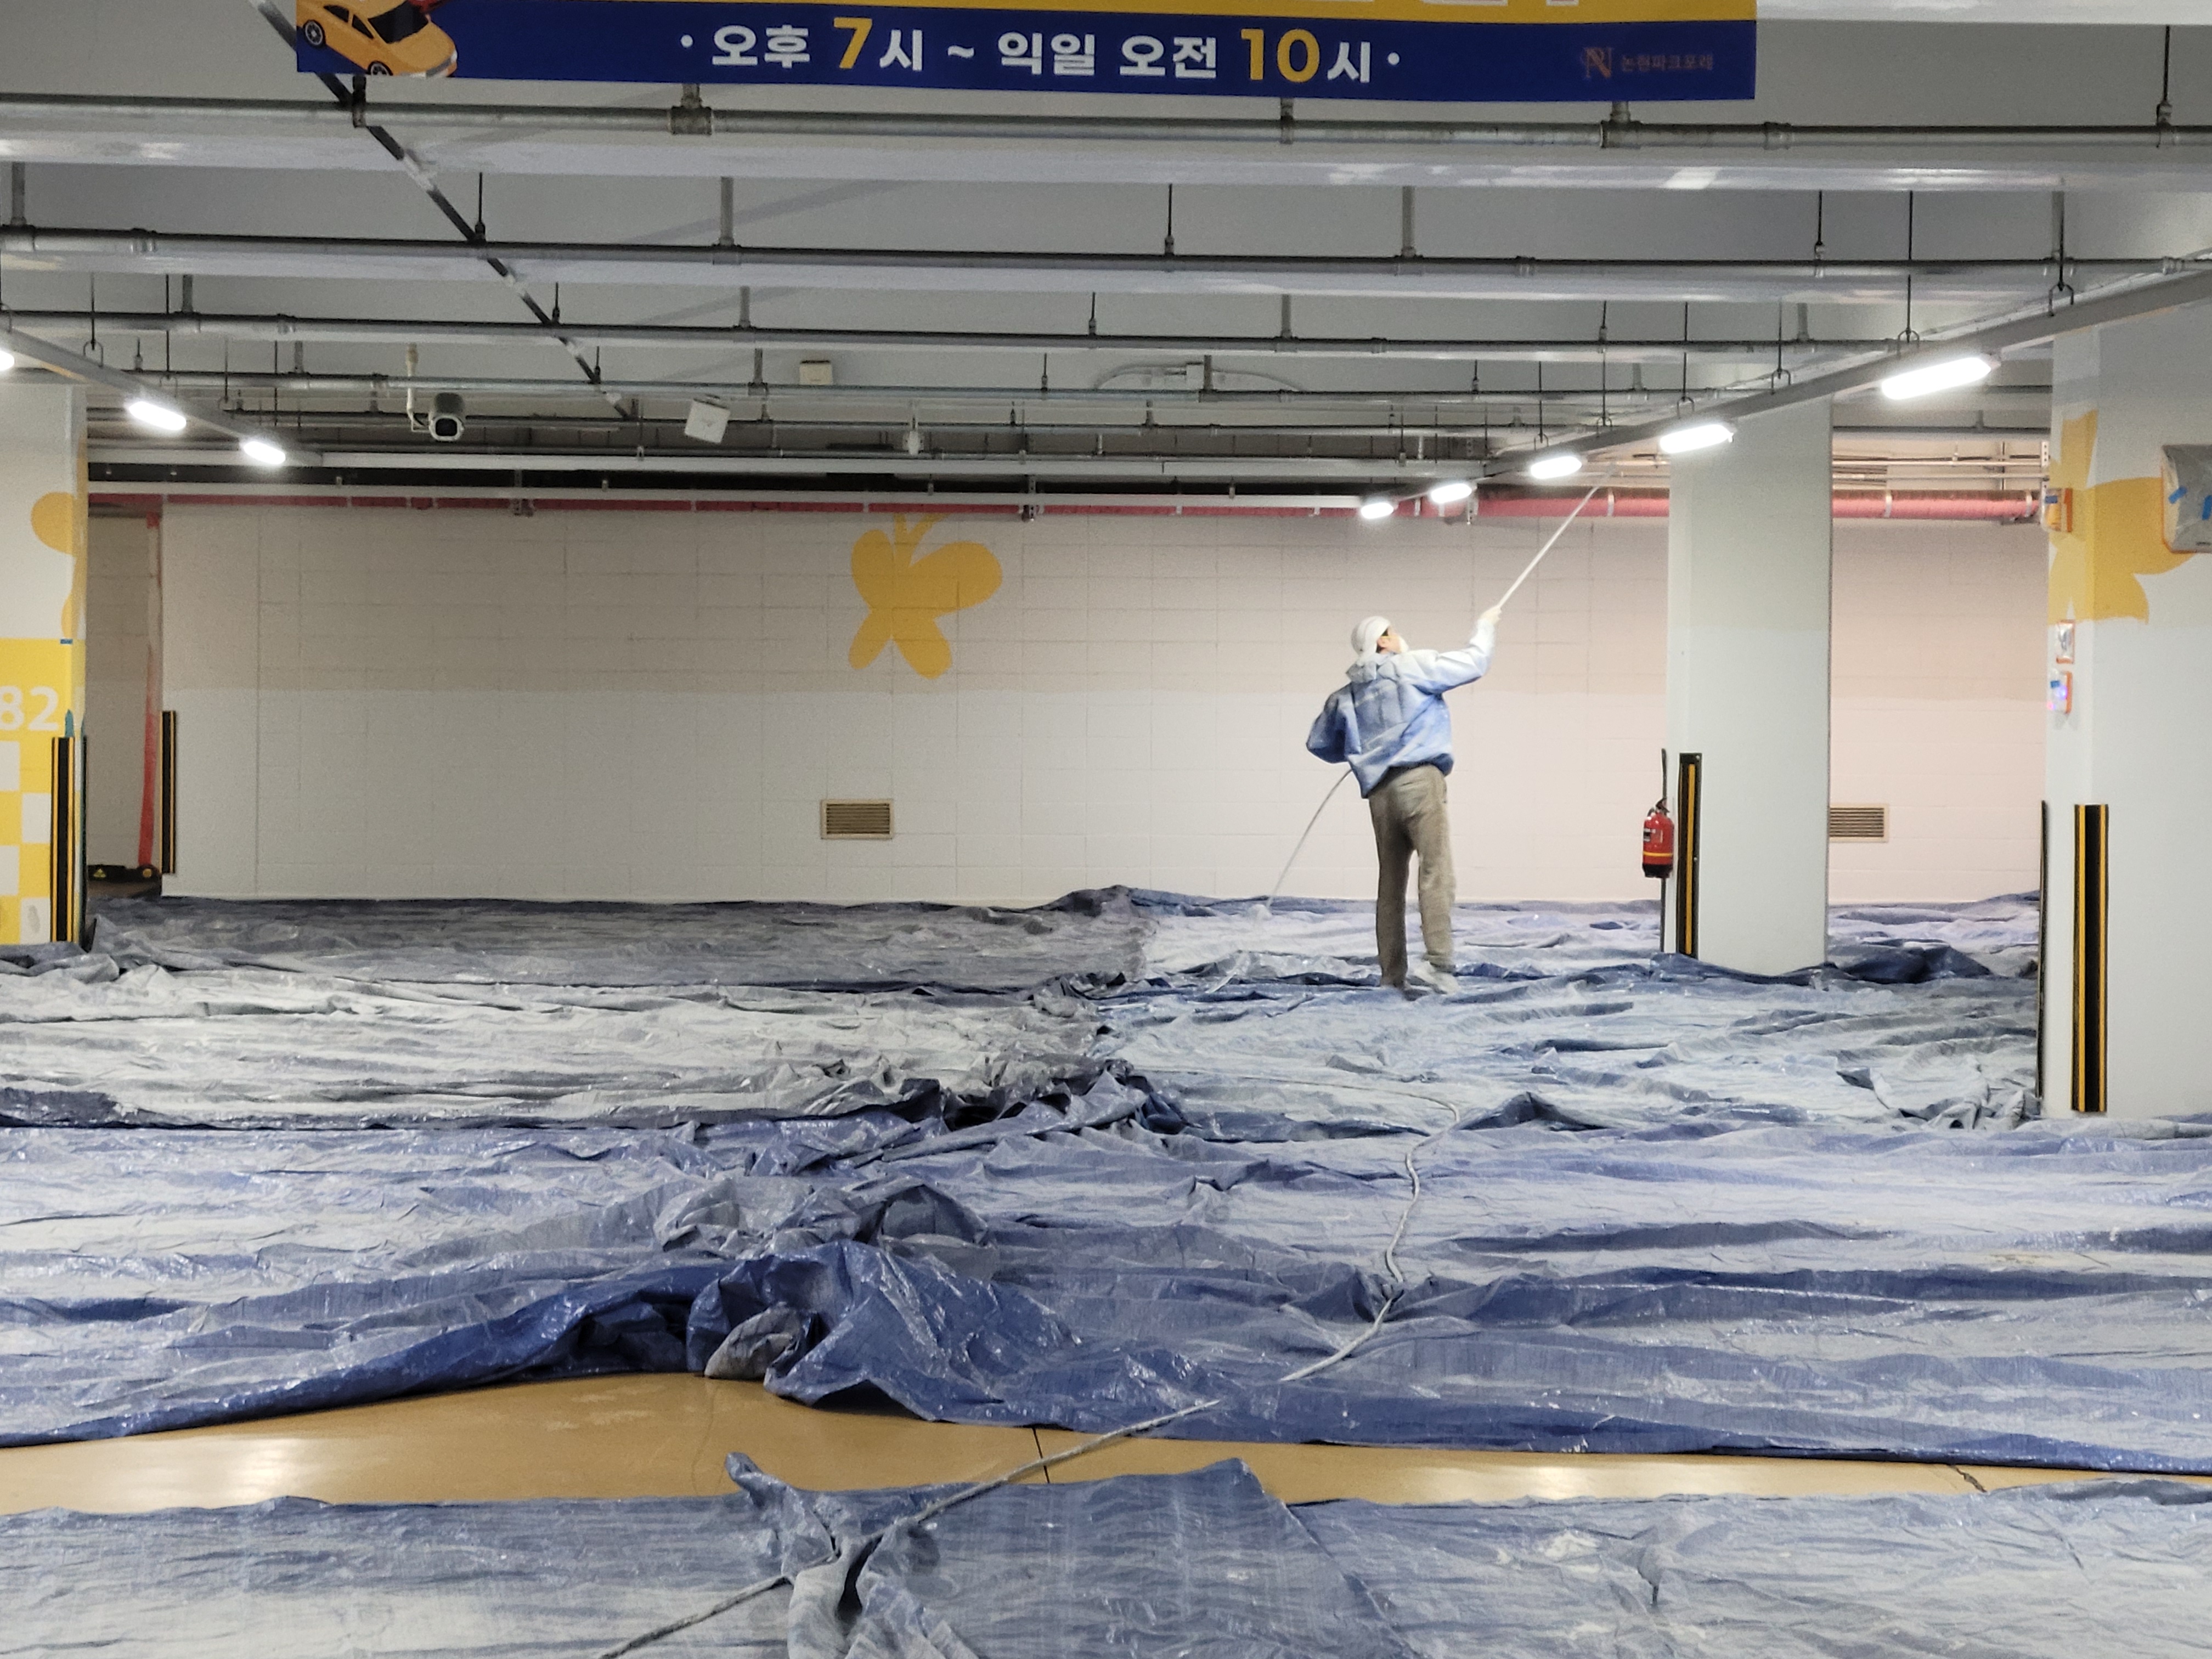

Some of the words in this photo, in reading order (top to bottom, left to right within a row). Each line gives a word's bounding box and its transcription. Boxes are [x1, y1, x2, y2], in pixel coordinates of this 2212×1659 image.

[712, 24, 810, 68] 오후
[833, 17, 923, 71] 7시
[998, 32, 1095, 76] 익일
[1119, 35, 1217, 78] 오전
[1241, 29, 1371, 83] 10시
